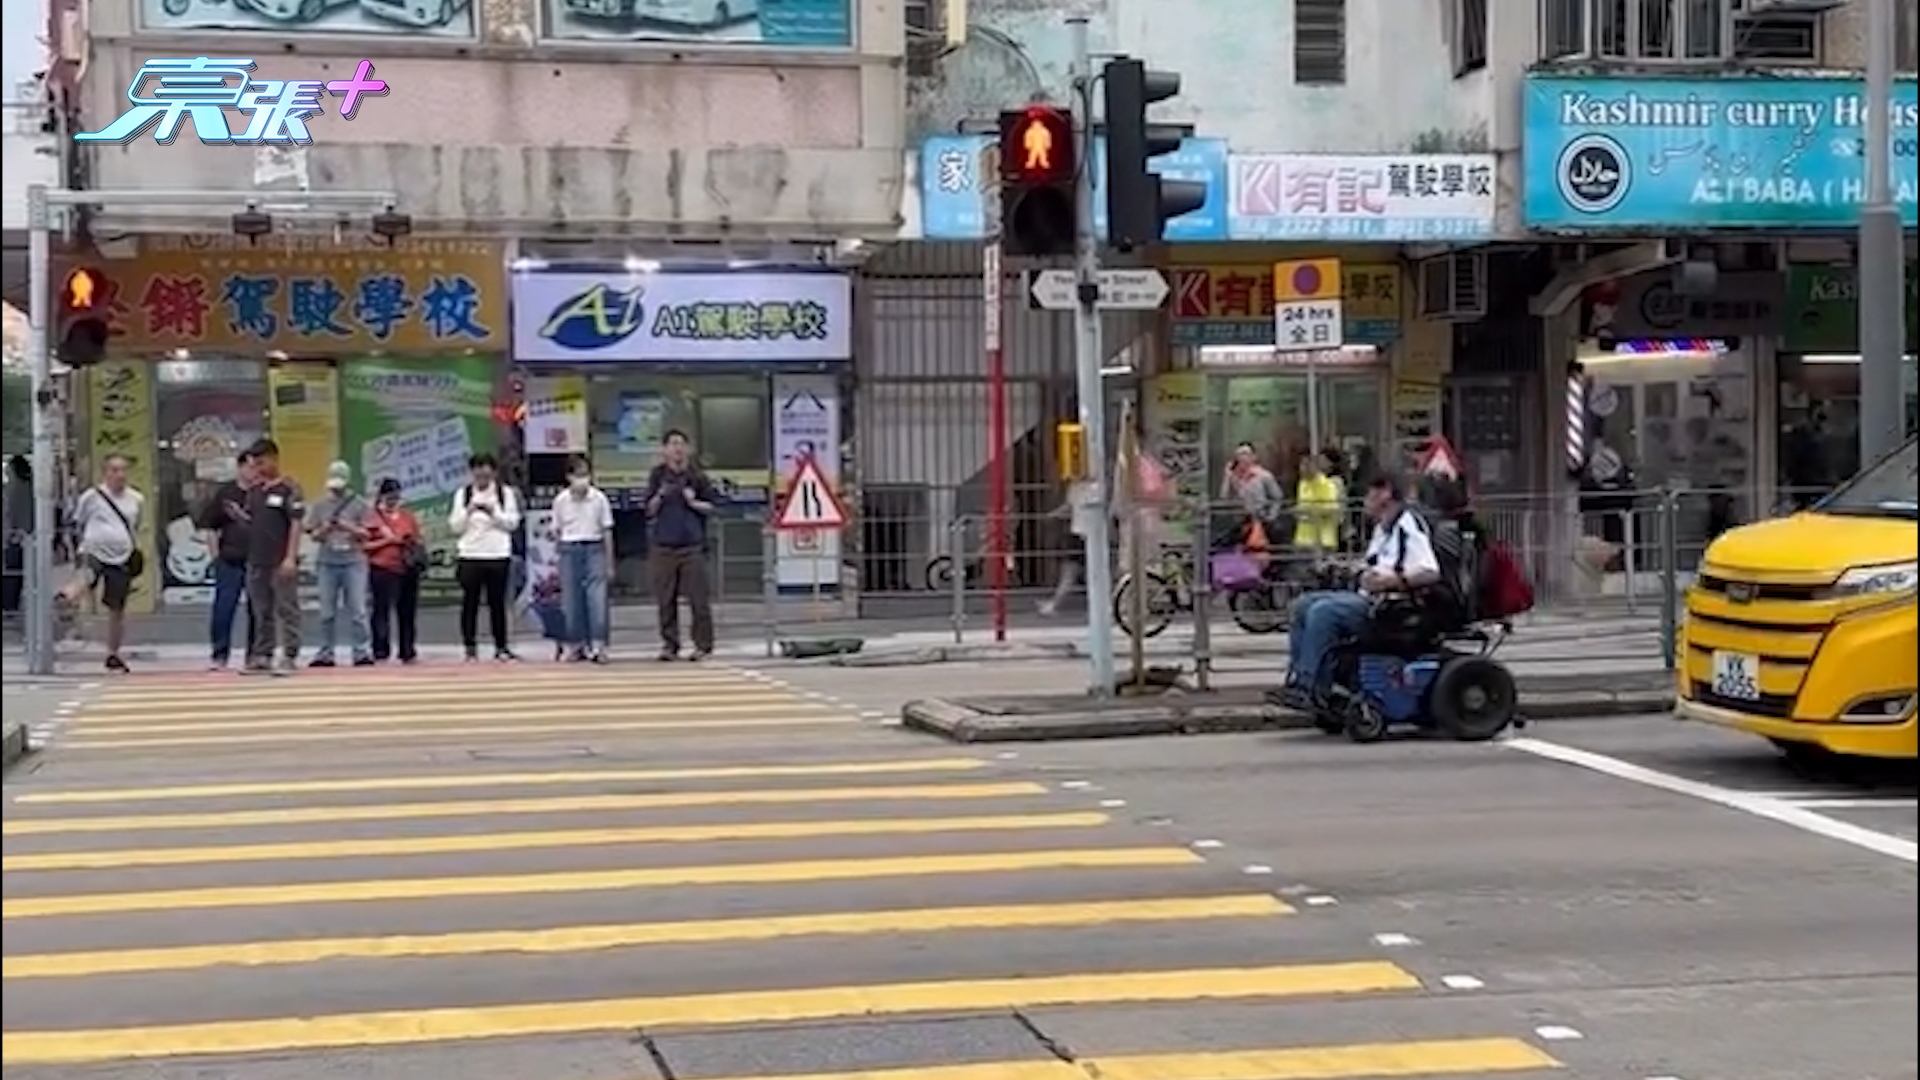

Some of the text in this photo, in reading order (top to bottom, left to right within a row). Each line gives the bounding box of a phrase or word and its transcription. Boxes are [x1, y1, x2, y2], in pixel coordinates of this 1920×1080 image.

[1559, 92, 1717, 127] Kashmir
[1726, 99, 1824, 136] curry
[1285, 163, 1491, 214] 有記 駕駛學校
[1746, 177, 1815, 204] BABA
[1283, 306, 1334, 322] 24 hrs
[1290, 324, 1330, 344] 全日
